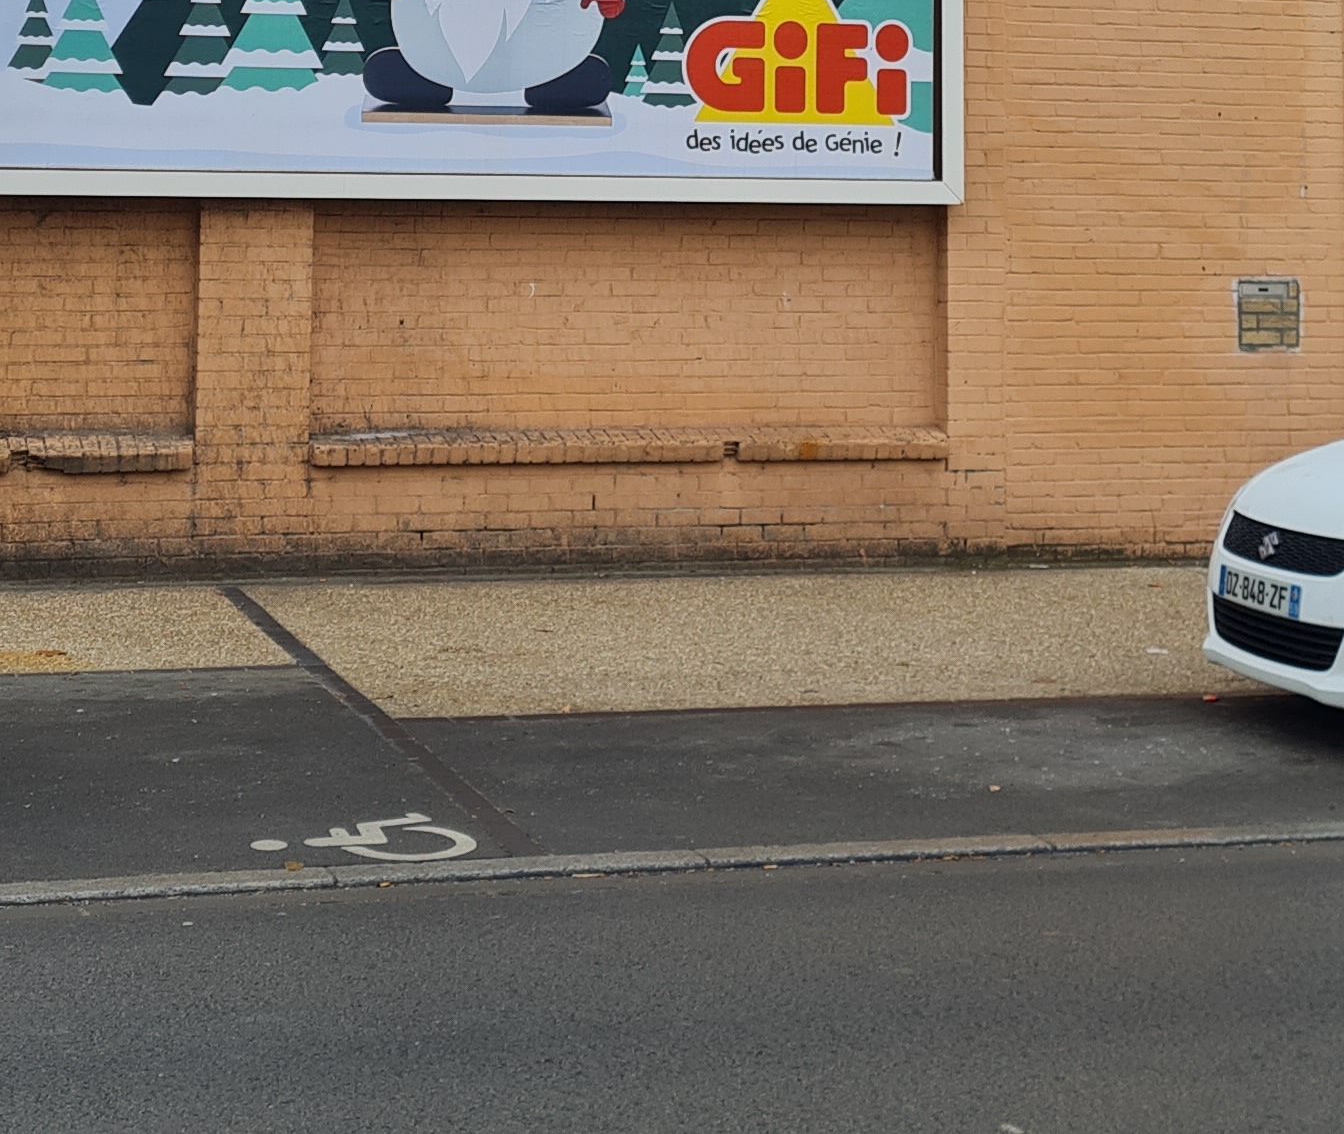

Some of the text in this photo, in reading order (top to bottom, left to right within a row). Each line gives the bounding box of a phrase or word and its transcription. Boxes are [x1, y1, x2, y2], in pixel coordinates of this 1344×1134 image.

[686, 20, 910, 116] GiFi
[685, 128, 722, 152] des
[729, 128, 785, 153] idées
[792, 130, 818, 153] de
[824, 130, 883, 154] Génie
